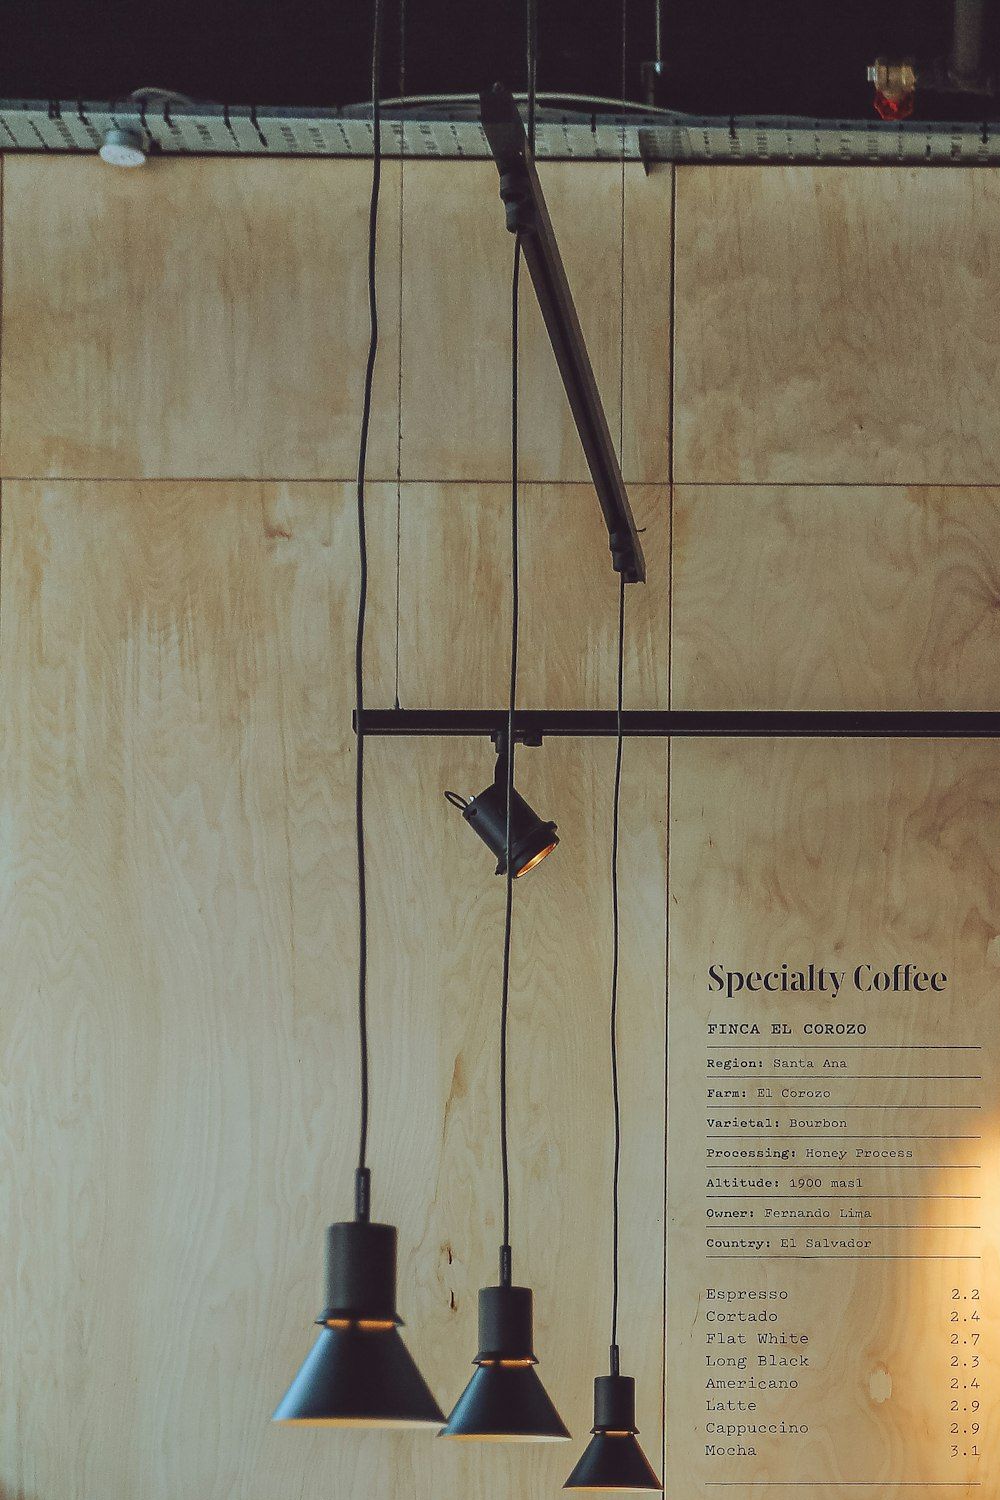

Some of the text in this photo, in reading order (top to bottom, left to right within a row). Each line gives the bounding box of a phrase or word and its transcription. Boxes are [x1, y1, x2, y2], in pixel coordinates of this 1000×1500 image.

[709, 964, 947, 998] Specialty Coffee
[708, 1024, 866, 1034] FINCA EL COROZO
[707, 1059, 847, 1070] Region: Santa Ana
[707, 1089, 830, 1097] Farm: El Corozo
[707, 1117, 847, 1127] Varietal: Bourbon
[707, 1149, 912, 1160] Processing: Honey Process
[706, 1178, 862, 1188] Altitude: 1900 masl
[707, 1209, 871, 1218] Owner: Fernando Lima
[707, 1239, 871, 1250] Country: El Salvador
[706, 1289, 979, 1302] Espresso 2.2
[707, 1311, 980, 1321] Cortado 2.4
[706, 1333, 979, 1345] Flat White 2.7
[706, 1355, 979, 1369] Long Black 2.3
[706, 1377, 980, 1389] Americano 2.4
[706, 1400, 979, 1412] Latte 2.9
[706, 1422, 979, 1436] Cappuccino 2.9
[706, 1445, 980, 1457] Mocha 3.1
